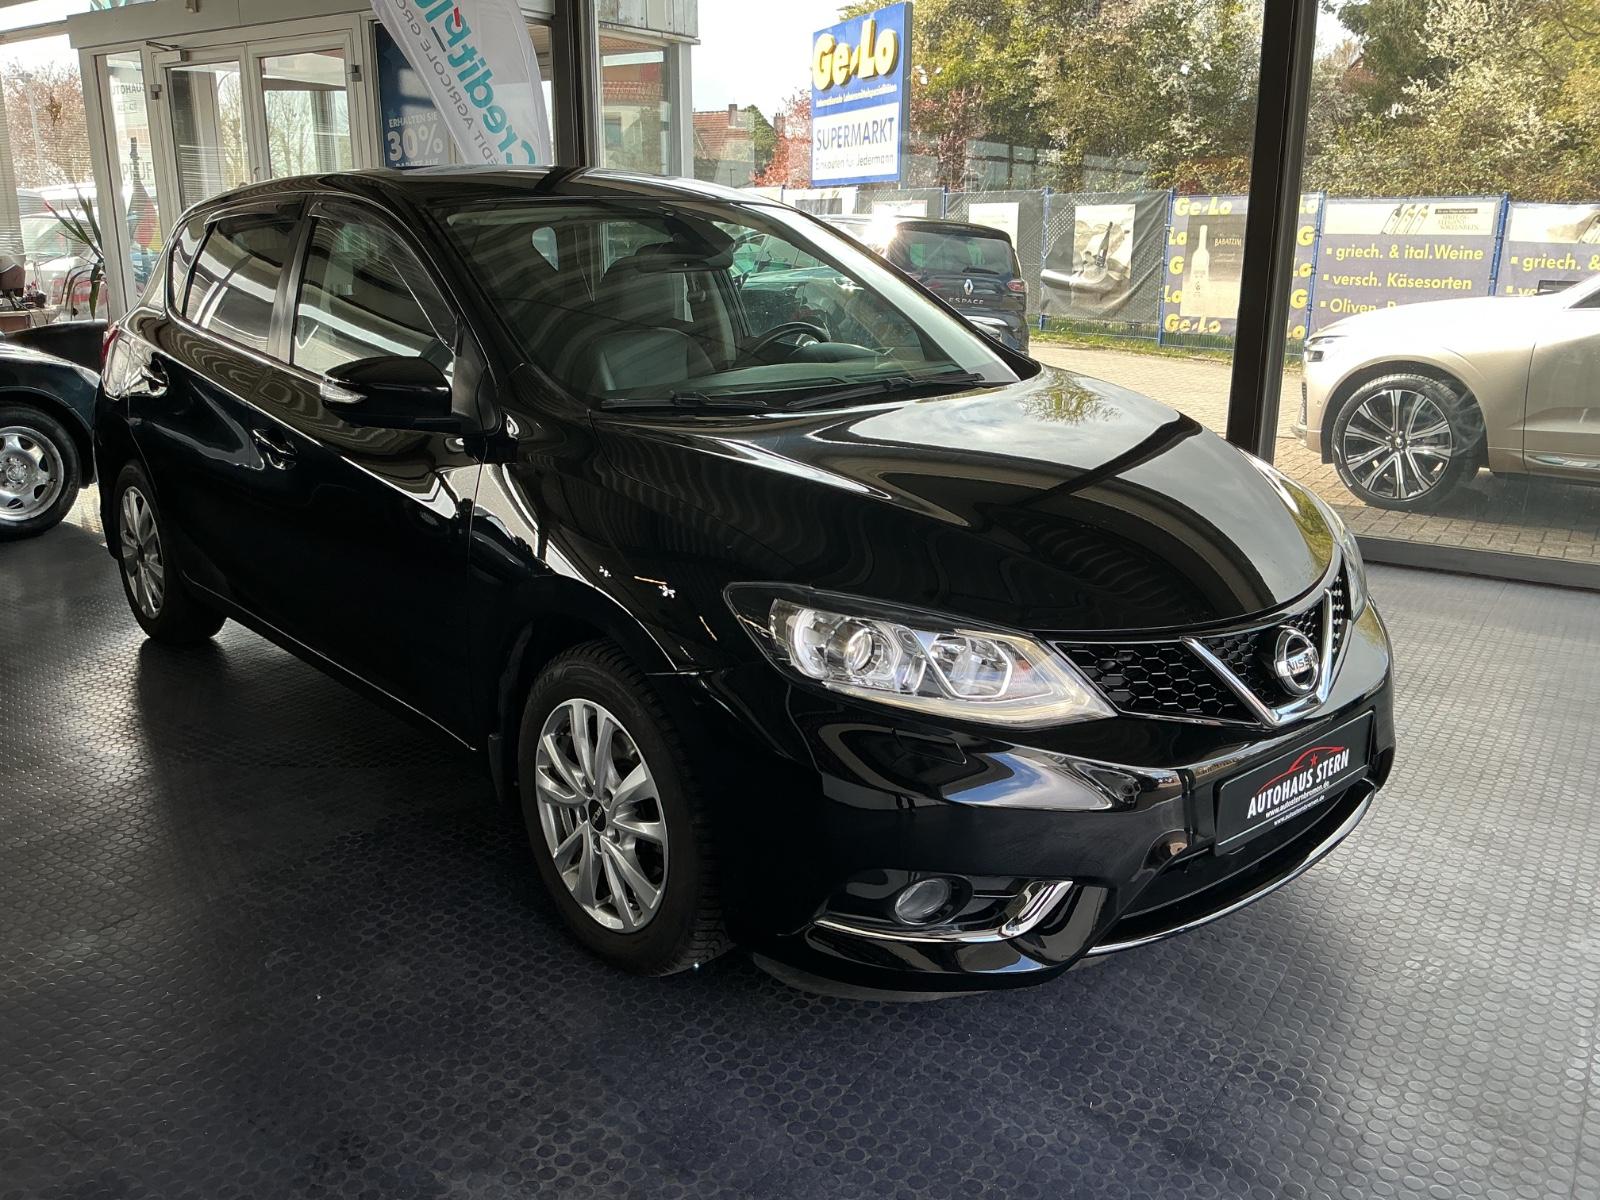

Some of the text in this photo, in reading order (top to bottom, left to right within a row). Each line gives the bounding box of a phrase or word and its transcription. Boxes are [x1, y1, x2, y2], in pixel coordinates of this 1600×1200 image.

[388, 111, 438, 128] ERHALTEN SIE
[387, 123, 444, 161] 30%
[816, 117, 894, 151] SUPERMARKT
[856, 152, 894, 167] Jedermann
[1174, 196, 1232, 216] Ge-Lo
[1335, 243, 1384, 262] griech.
[1388, 246, 1400, 259] &
[1522, 252, 1582, 272] griech.
[1332, 270, 1473, 290] versch. Käsesorten
[948, 297, 984, 305] ESPACE
[1165, 312, 1221, 333] Ge-Lo
[1246, 748, 1349, 819] AUTOHAUS STERN
